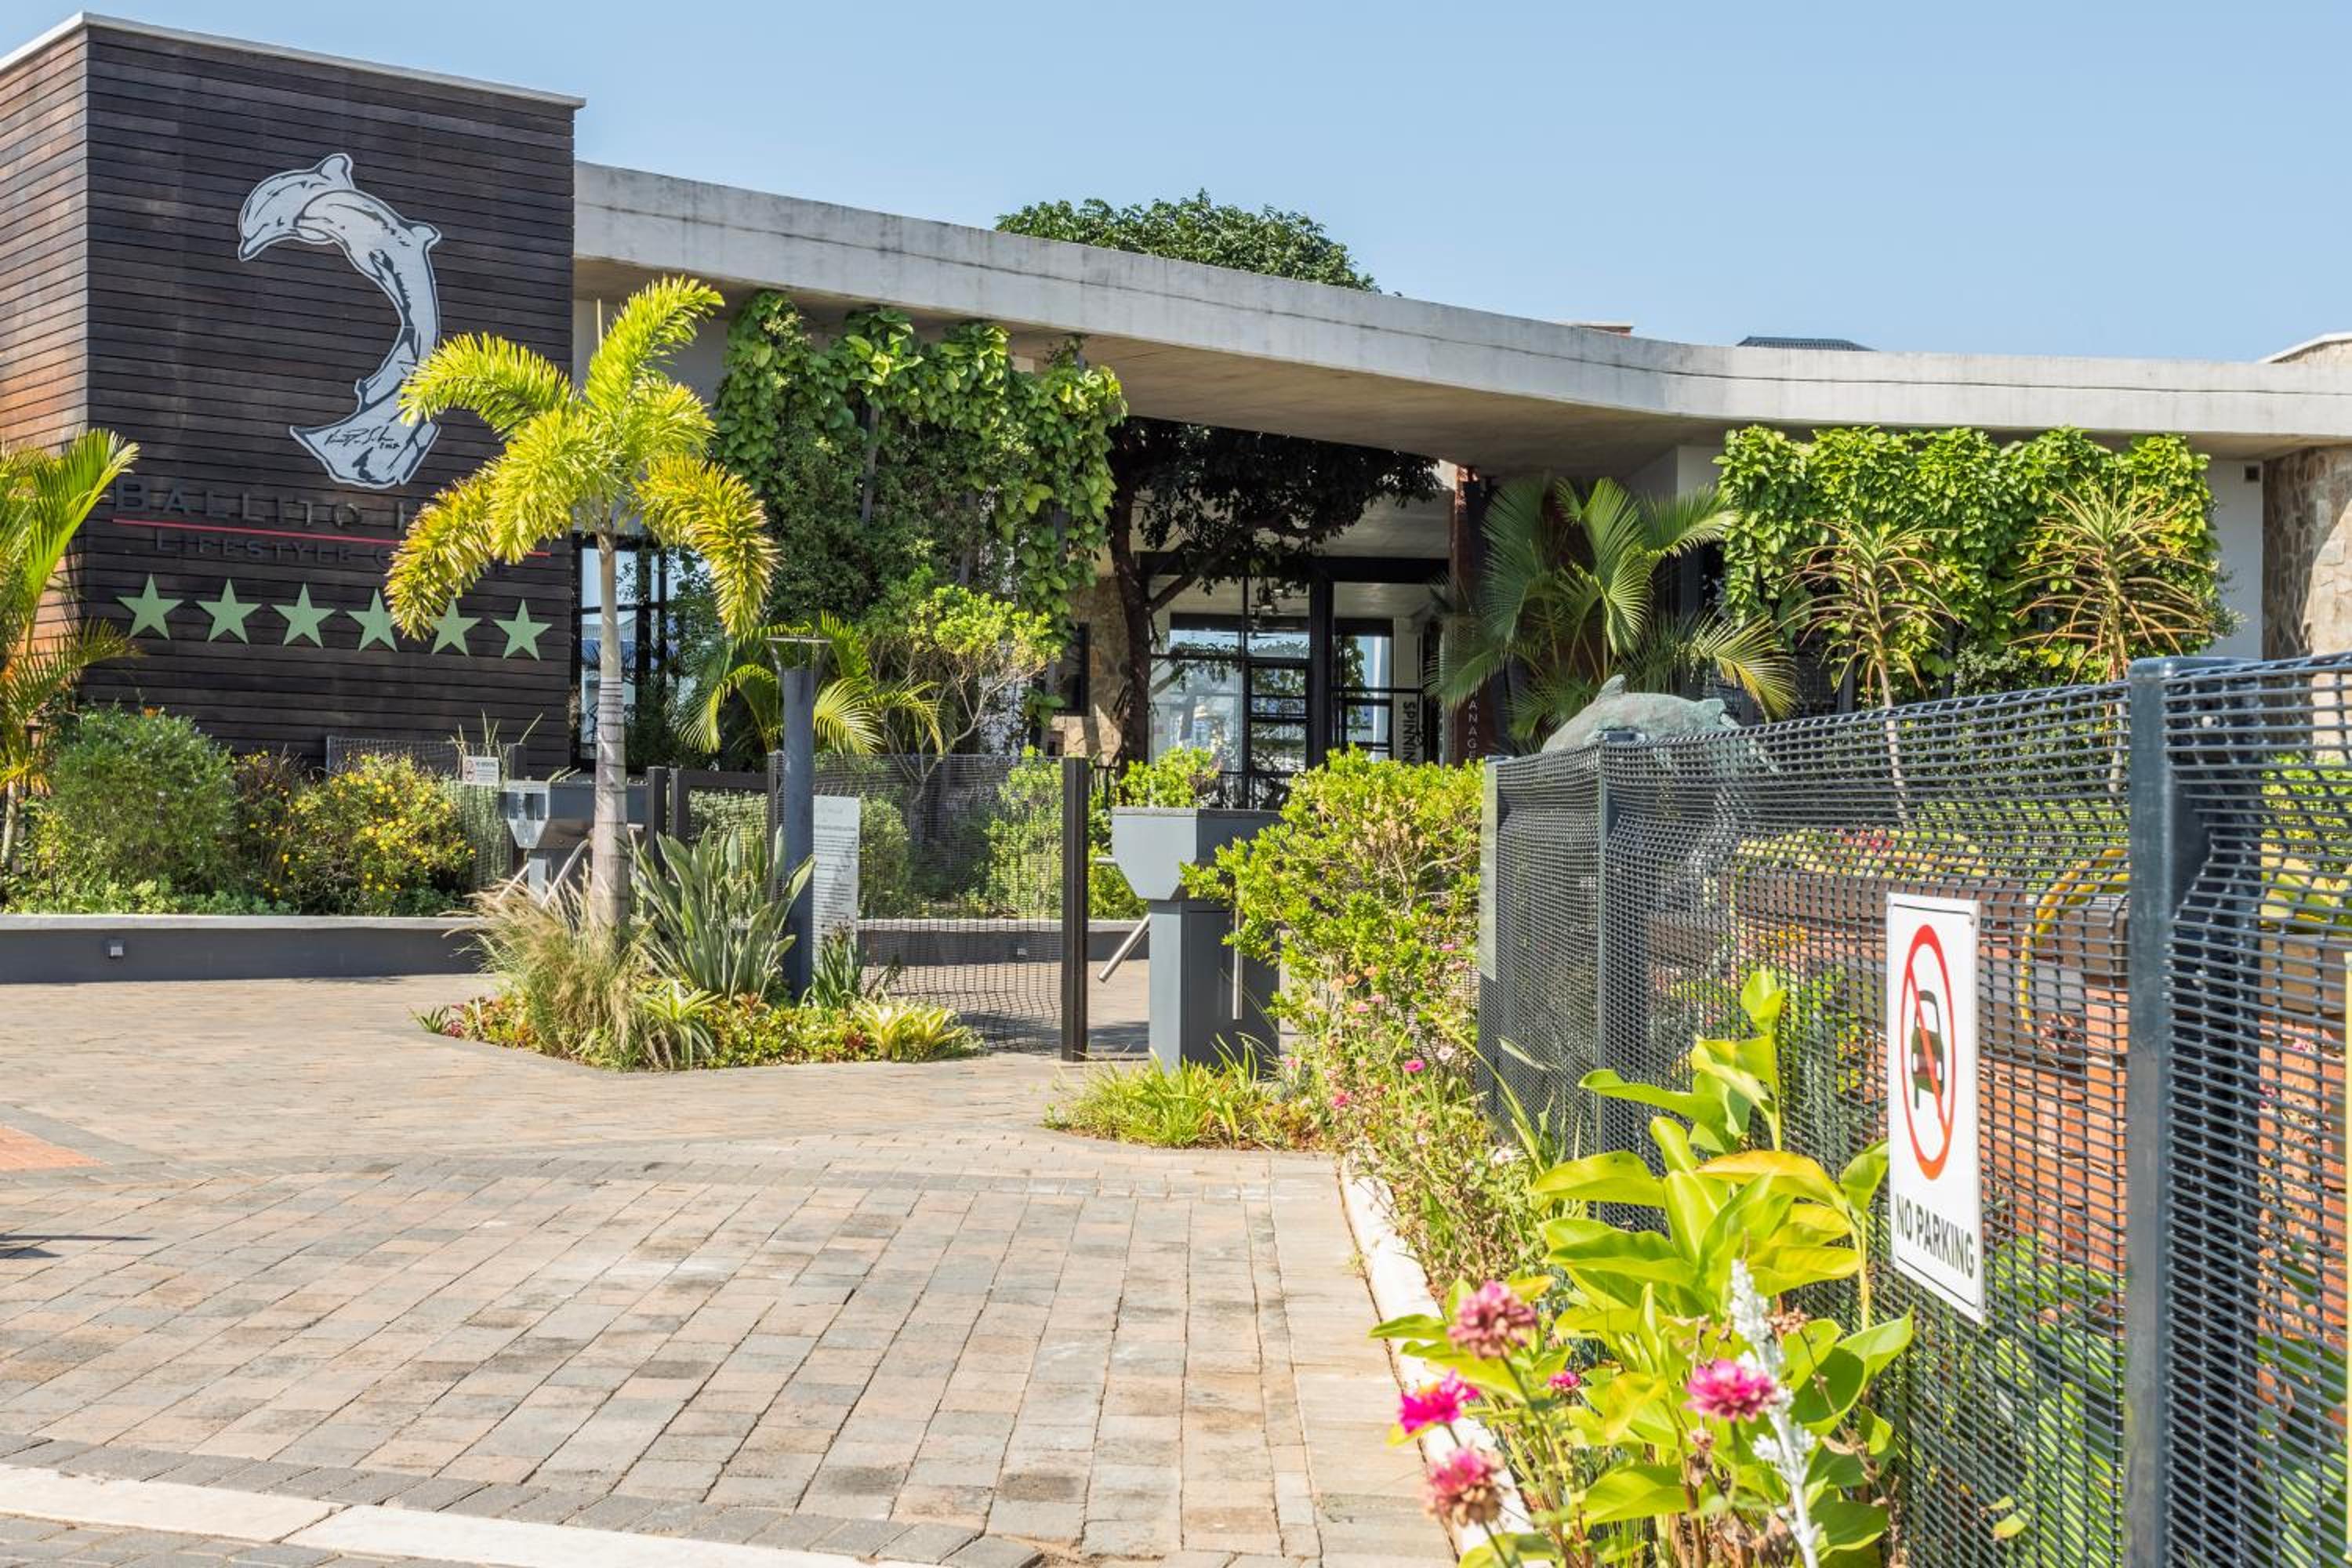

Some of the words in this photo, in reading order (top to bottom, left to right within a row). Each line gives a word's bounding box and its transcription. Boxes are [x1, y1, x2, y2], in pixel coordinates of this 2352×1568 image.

[115, 476, 361, 527] BALLITO
[158, 528, 350, 564] LIFESTYLE
[1468, 688, 1479, 761] ANAGE
[1896, 1194, 1912, 1240] NO
[1917, 1205, 1974, 1279] PARKING
